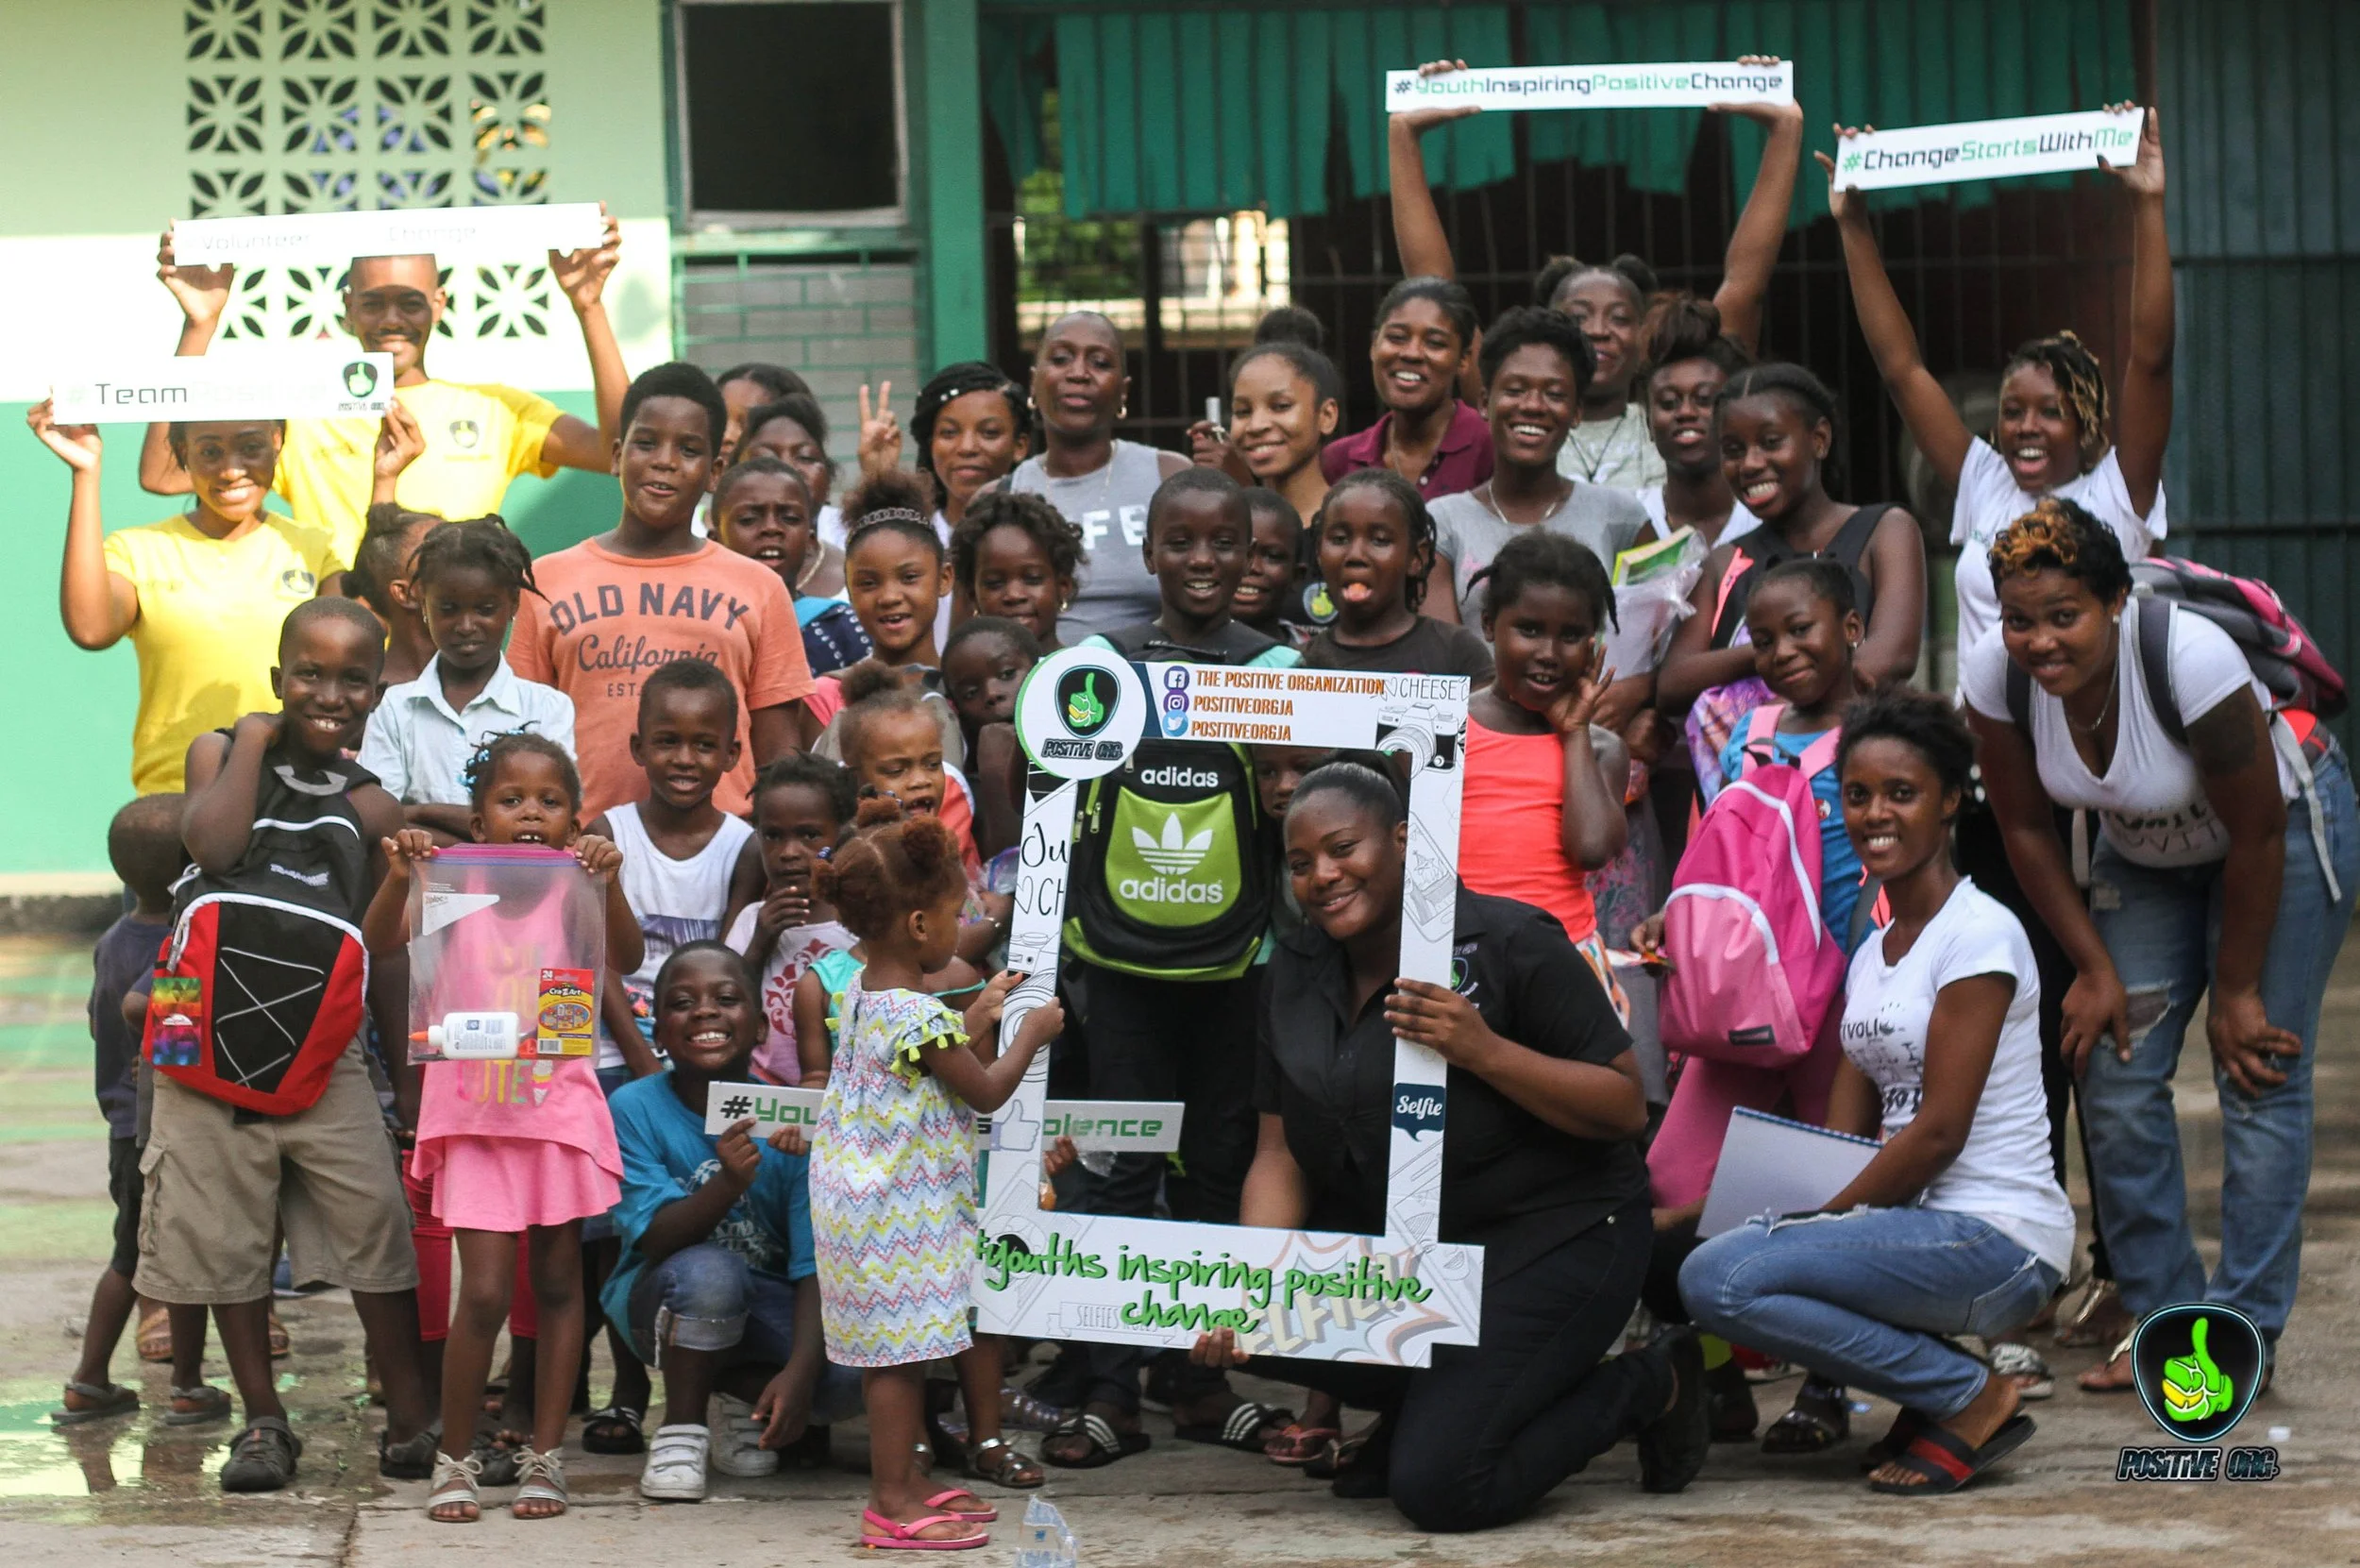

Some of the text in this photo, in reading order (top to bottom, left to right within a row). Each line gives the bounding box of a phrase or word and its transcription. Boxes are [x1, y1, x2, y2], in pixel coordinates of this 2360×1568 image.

[1394, 70, 1783, 96] #YouthInspiringPositiveChange
[1842, 126, 2133, 172] #ChangeStartsWithMe
[549, 582, 749, 636] OLD NAVY
[578, 633, 721, 674] California
[1196, 669, 1385, 696] THE POSITIVE ORGANIZATION
[1399, 678, 1458, 700] CHEESE
[1192, 695, 1294, 717] POSITIVEORGJA
[1190, 720, 1292, 742] POSITIVEORGJA
[1041, 738, 1096, 760] POSITIVE
[1140, 766, 1219, 788] adidas
[1119, 875, 1223, 903] adidas
[1395, 1094, 1443, 1121] Selfie
[1117, 1244, 1272, 1309] inspiring
[1284, 1255, 1433, 1310] positive
[1075, 1304, 1120, 1330] SELFIES
